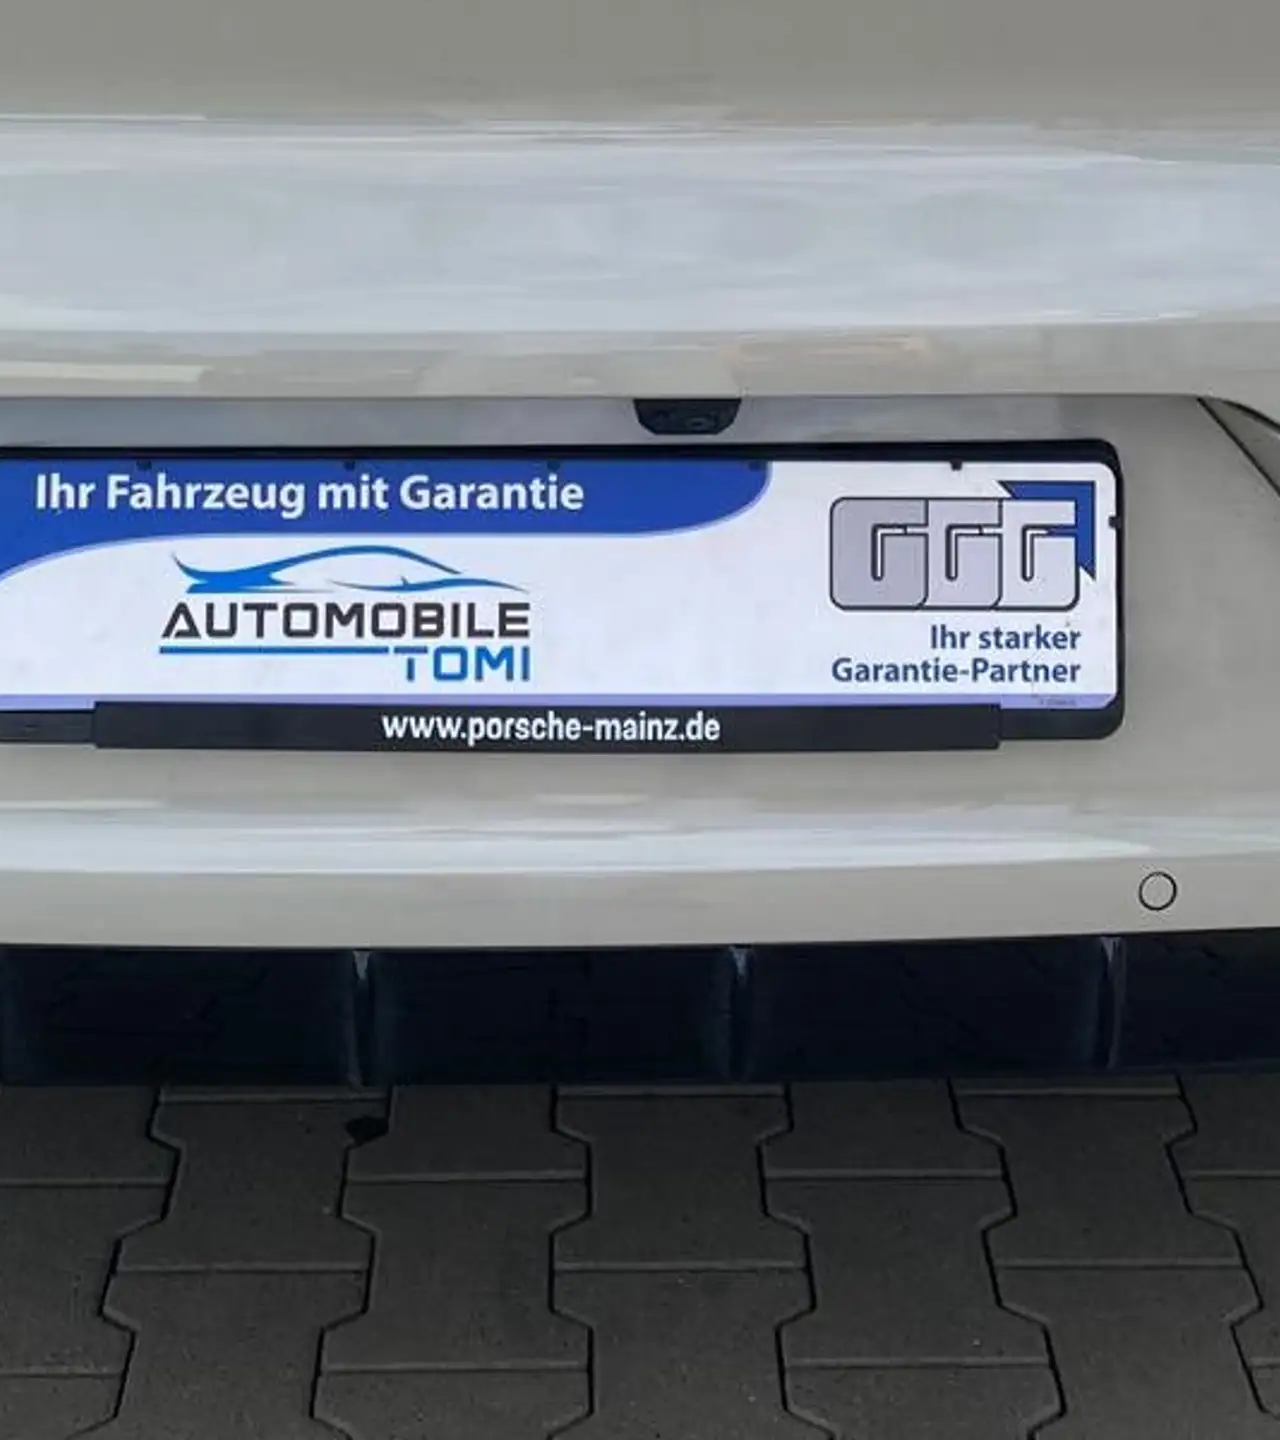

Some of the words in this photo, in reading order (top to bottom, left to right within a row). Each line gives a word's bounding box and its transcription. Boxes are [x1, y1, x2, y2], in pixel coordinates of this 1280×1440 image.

[35, 472, 95, 511] Ihr
[106, 472, 305, 518] Fahrzeug
[319, 473, 388, 511] mit
[400, 473, 585, 511] Garantie
[161, 601, 532, 639] AUTOMOBILE
[929, 624, 971, 651] Ihr
[978, 624, 1081, 651] starker
[392, 644, 531, 682] TOMI
[831, 657, 1081, 684] Garantie-Partner
[381, 711, 721, 747] www.porsche-mainz.de
